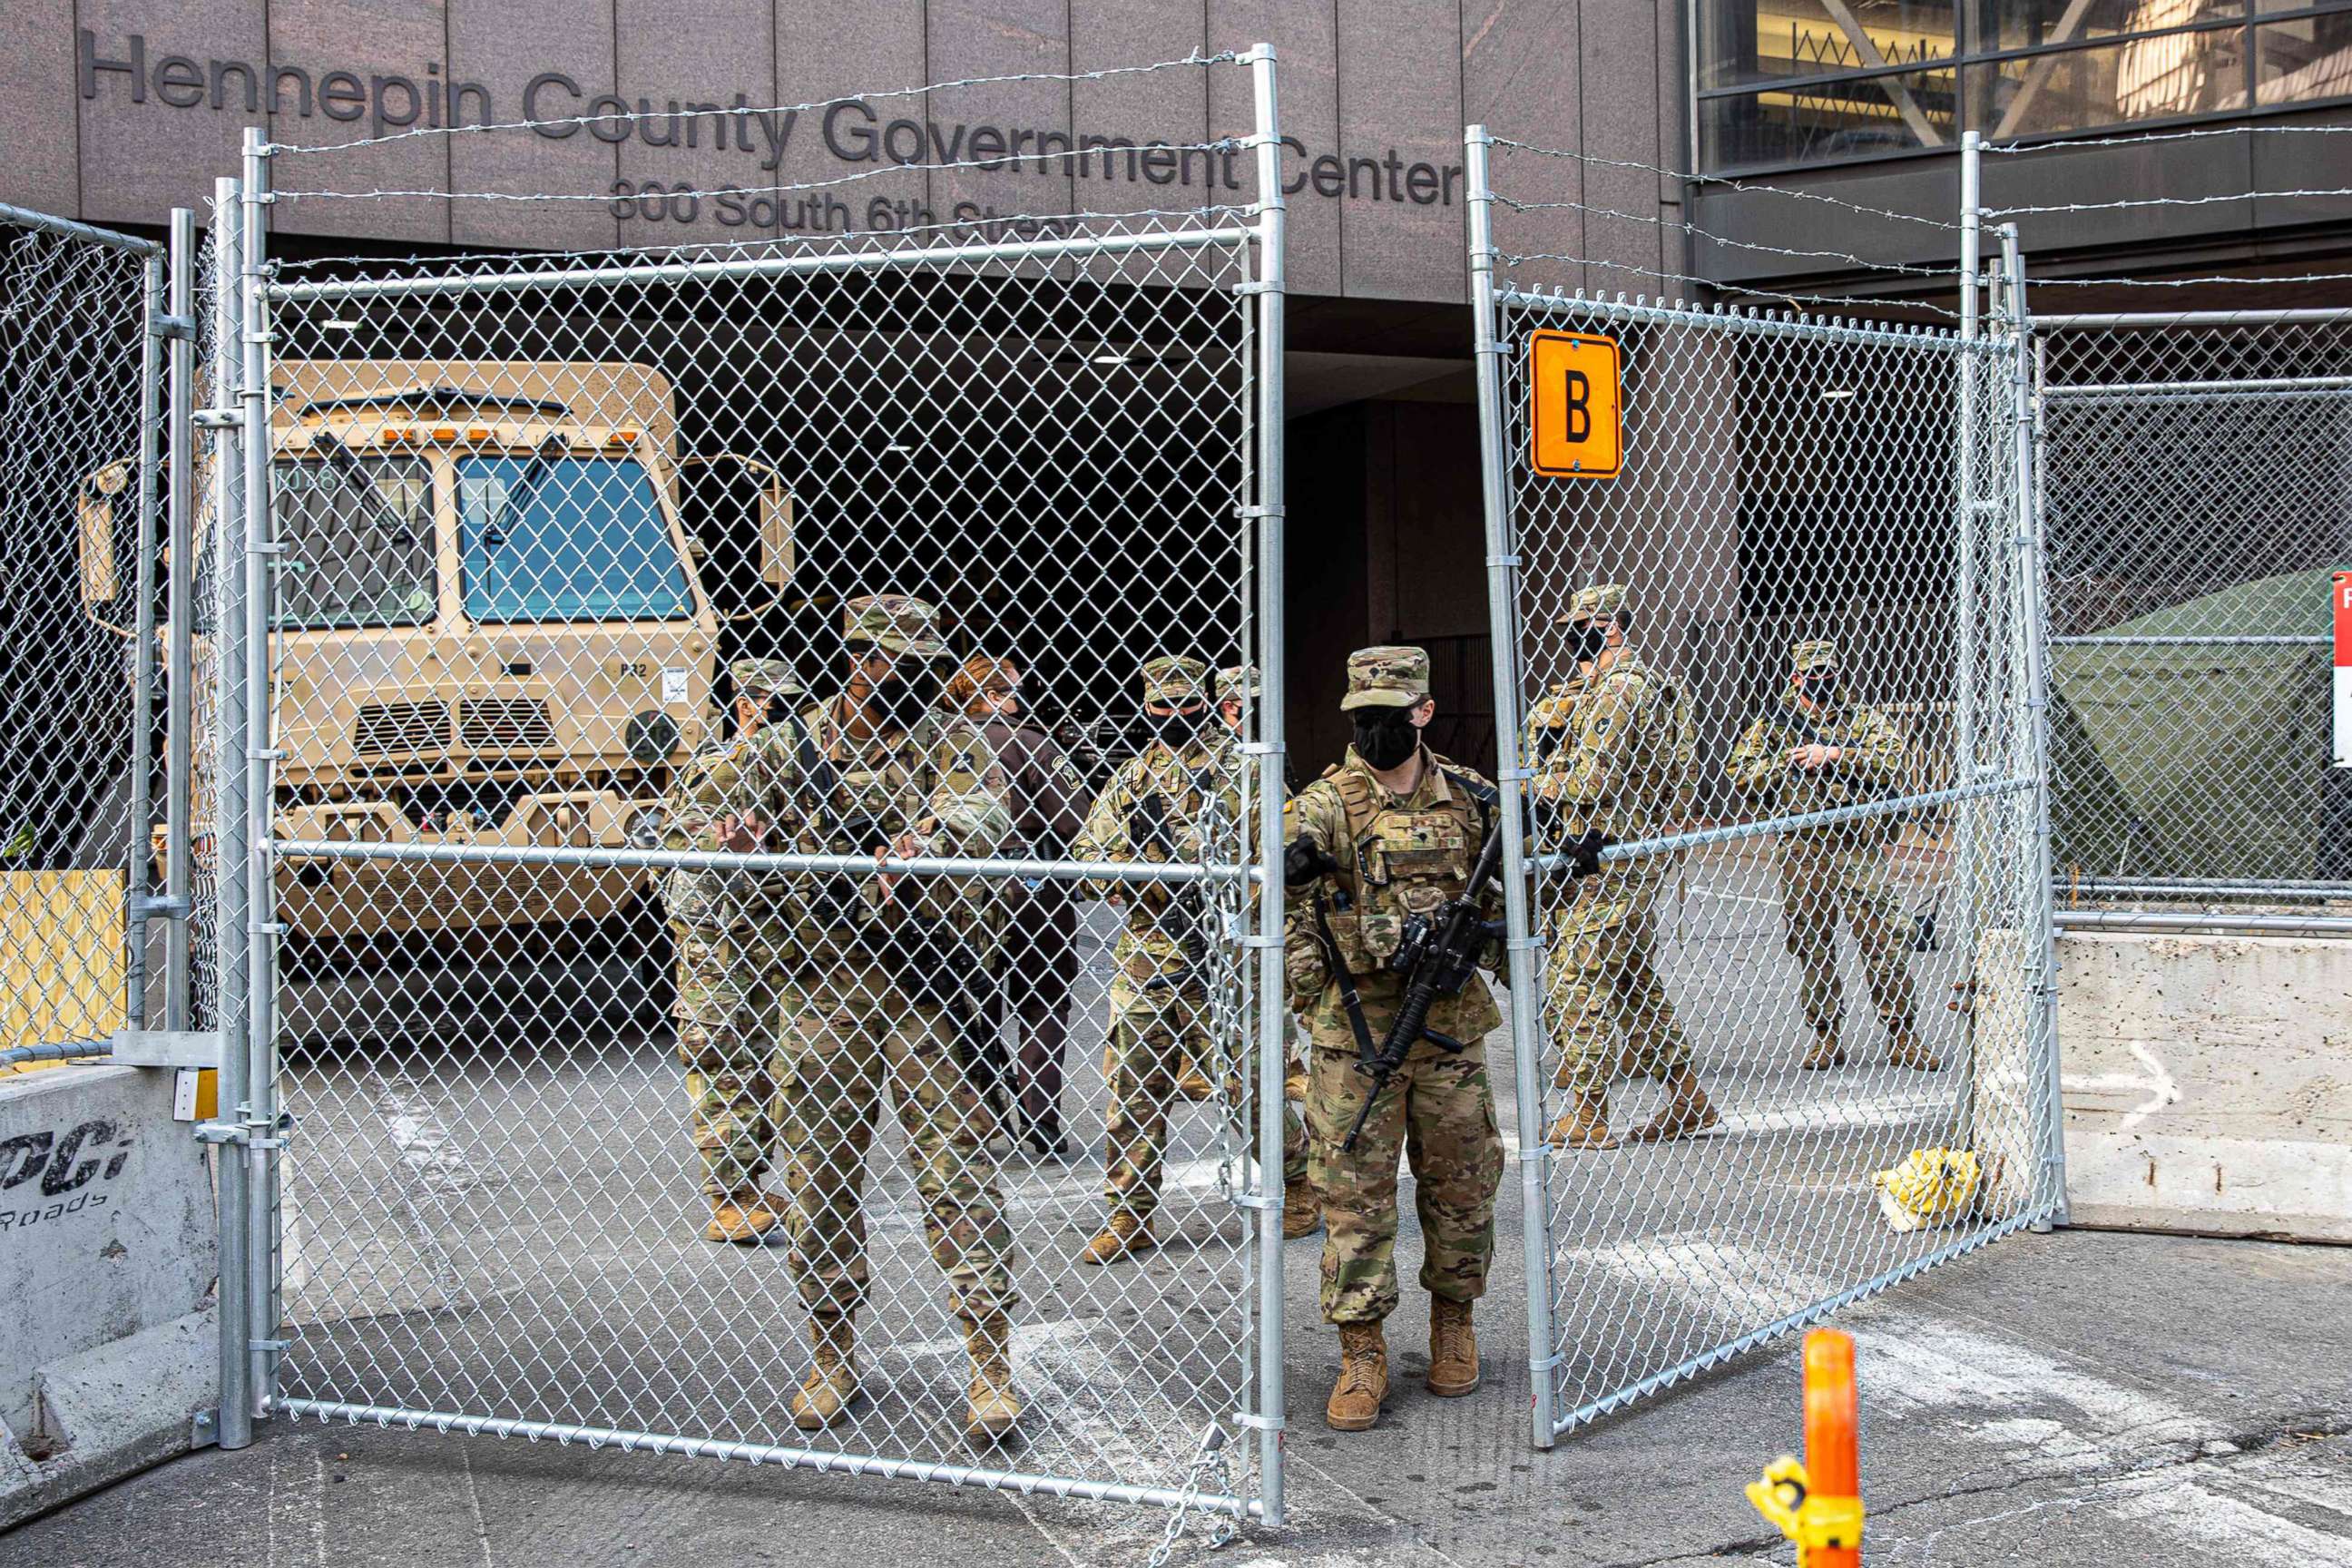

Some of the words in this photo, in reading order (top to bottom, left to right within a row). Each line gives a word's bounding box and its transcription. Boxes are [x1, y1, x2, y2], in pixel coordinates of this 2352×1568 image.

[80, 30, 492, 138] Hennepin
[524, 73, 798, 171] County
[821, 99, 1239, 191] Government
[1280, 135, 1462, 206] Center
[609, 179, 699, 223] 300
[715, 184, 851, 231] South
[867, 196, 937, 239] 6th
[1565, 369, 1592, 444] B
[0, 1192, 108, 1231] Roads
